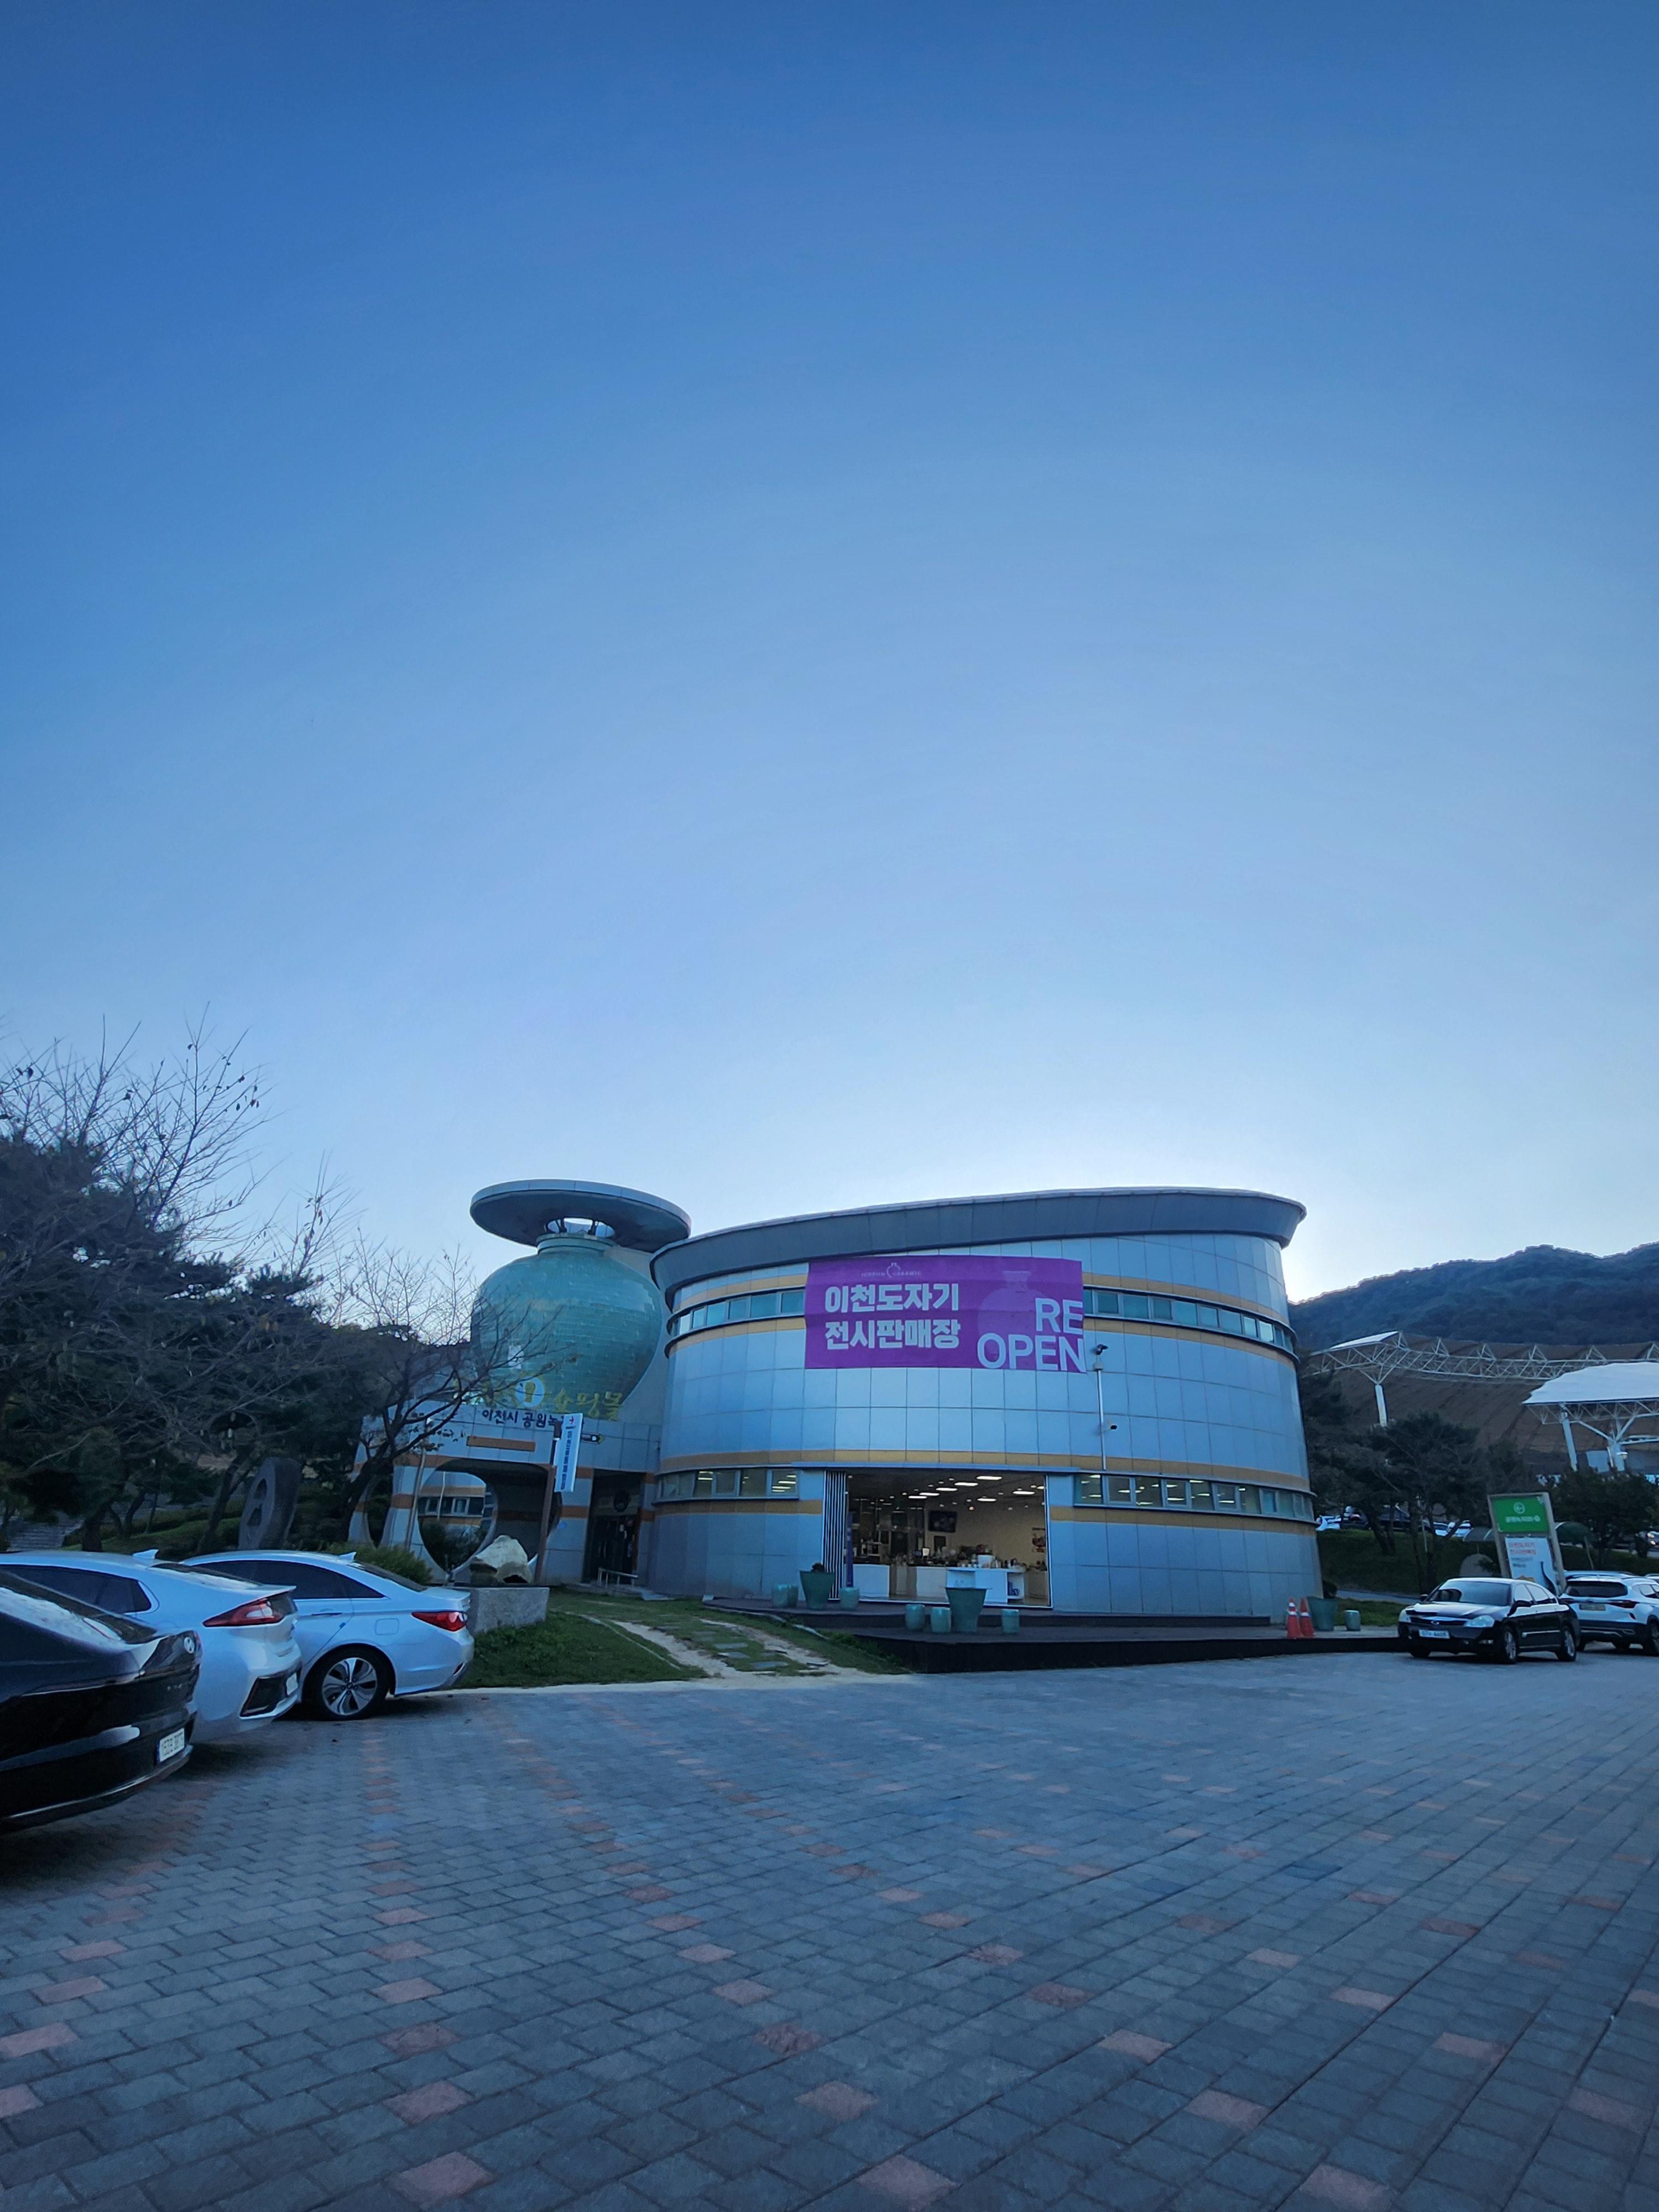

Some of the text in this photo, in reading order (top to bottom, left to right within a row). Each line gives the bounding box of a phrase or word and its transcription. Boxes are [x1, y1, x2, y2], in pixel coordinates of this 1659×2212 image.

[825, 1282, 959, 1313] 이천도자기
[1035, 1297, 1083, 1335] RE
[825, 1319, 961, 1350] 전시판매장
[977, 1332, 1087, 1374] OPEN
[482, 1409, 519, 1425] 이천시
